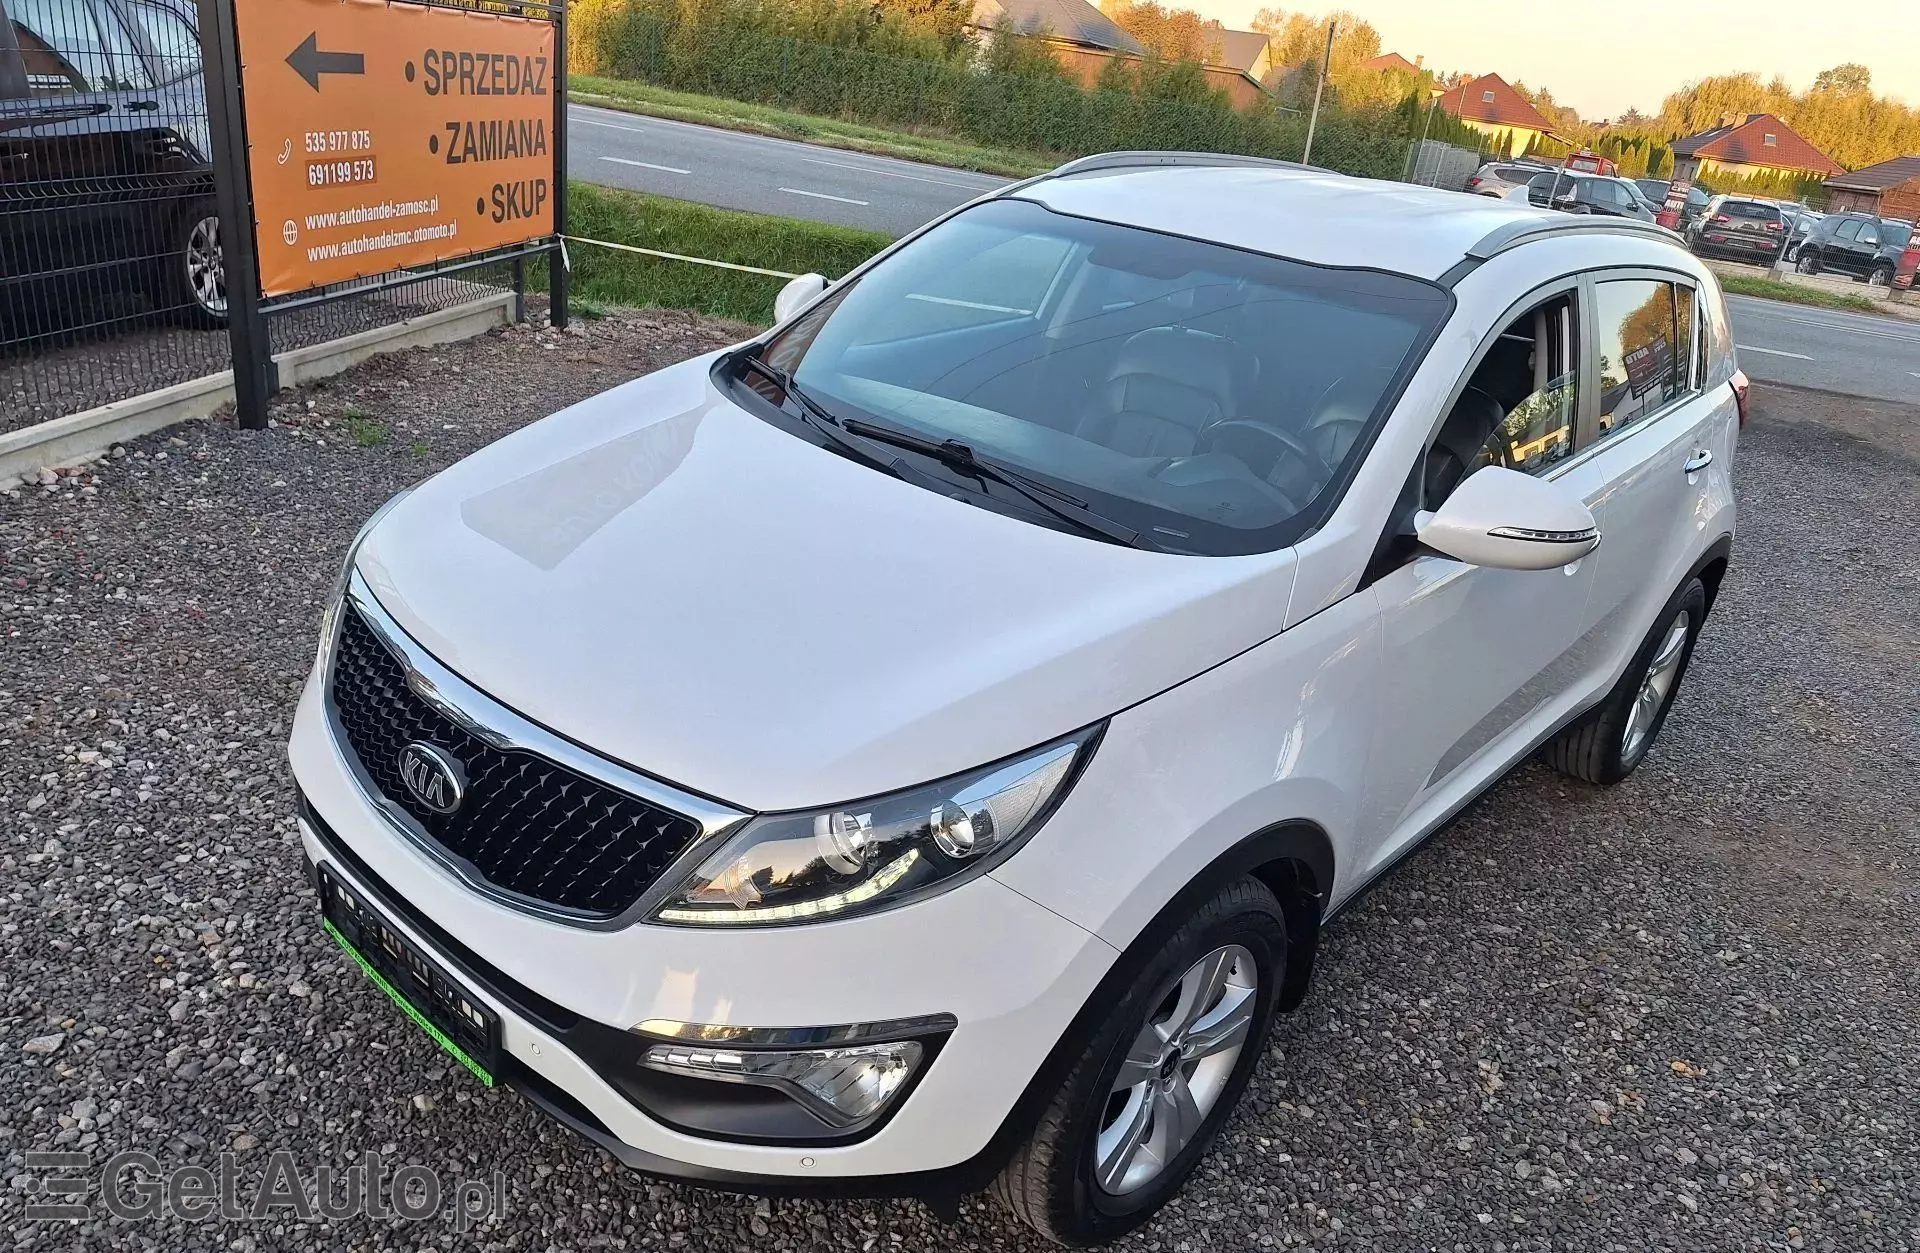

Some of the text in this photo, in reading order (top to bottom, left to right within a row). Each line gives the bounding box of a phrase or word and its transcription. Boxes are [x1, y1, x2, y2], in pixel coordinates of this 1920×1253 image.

[423, 46, 547, 96] SPRZEDAŻ
[305, 130, 371, 152] 535 977 875
[446, 119, 547, 164] ZAMIANA
[354, 160, 374, 181] 573
[305, 193, 439, 230] www.autohandel-zamosc.pl
[491, 179, 547, 223] SKUP
[307, 218, 457, 262] www.autohandelzmc.otomoto.pl
[404, 751, 445, 807] KIA
